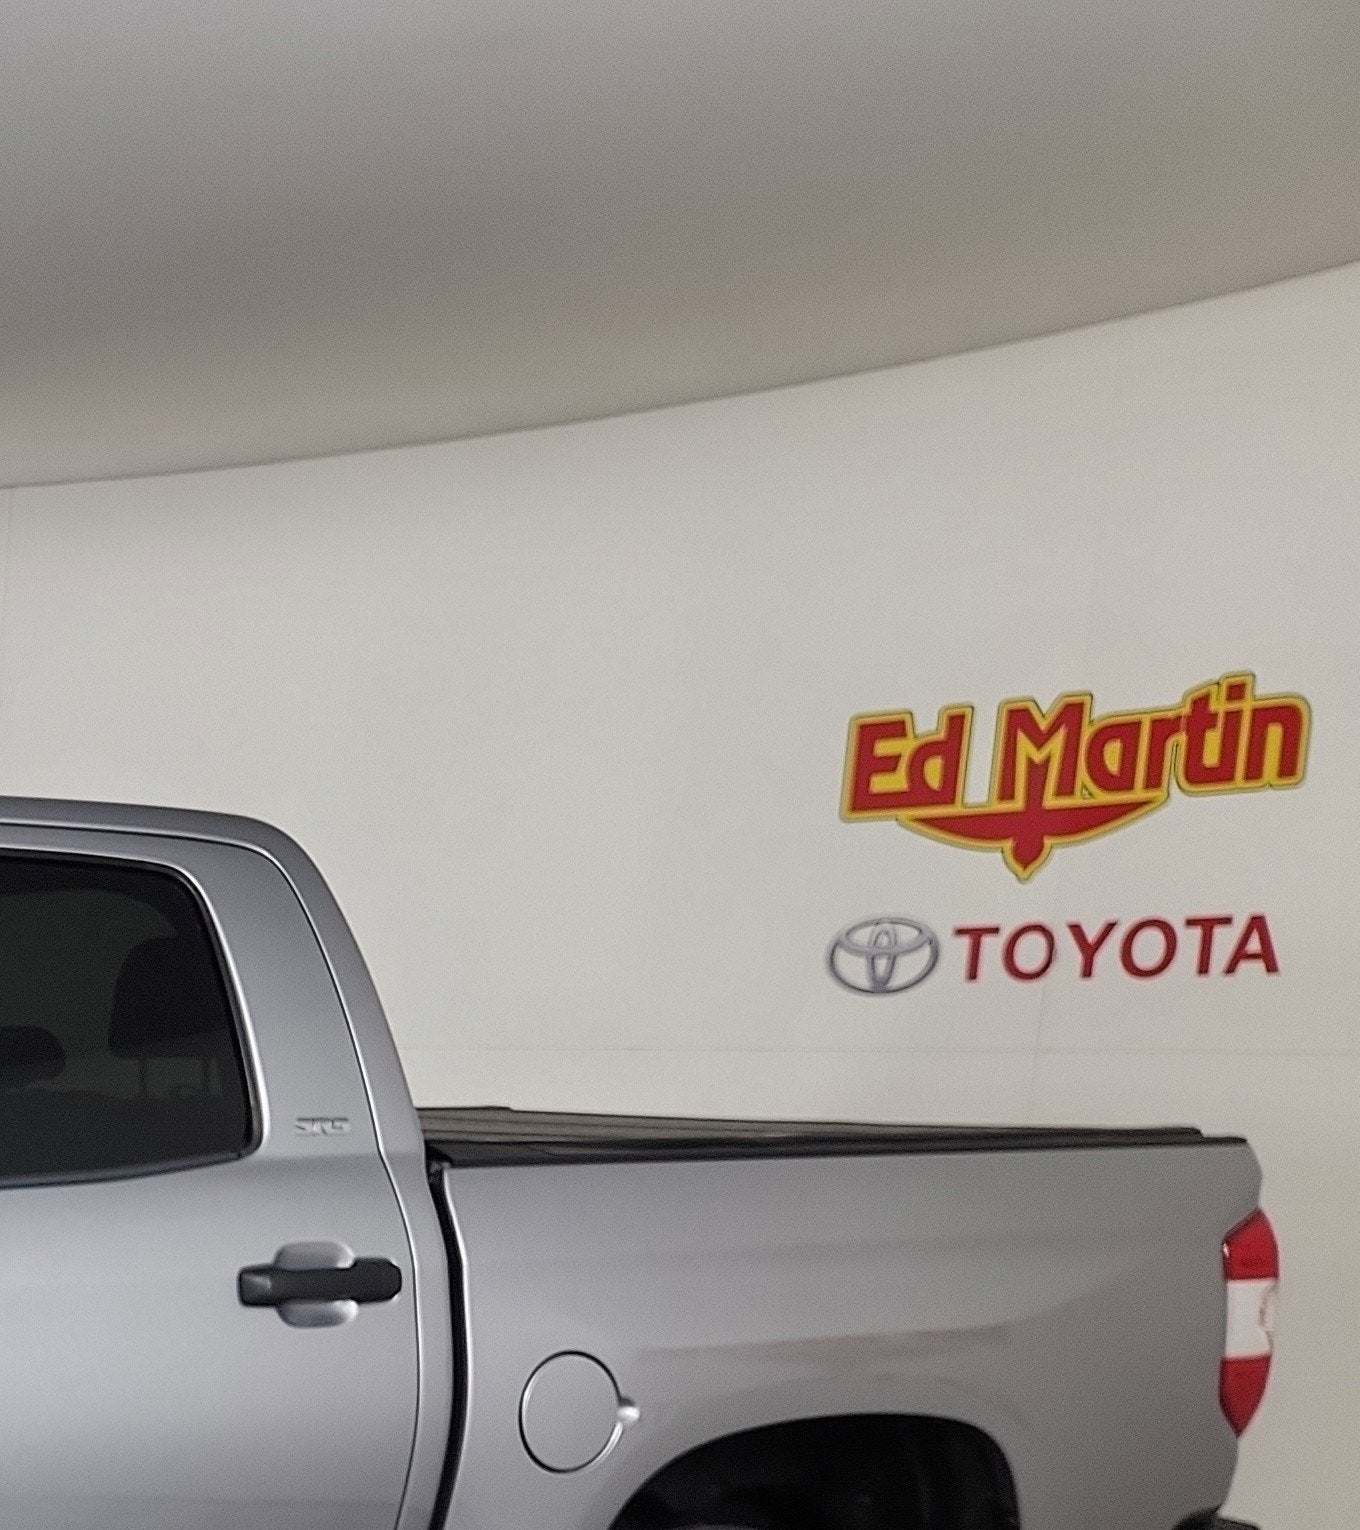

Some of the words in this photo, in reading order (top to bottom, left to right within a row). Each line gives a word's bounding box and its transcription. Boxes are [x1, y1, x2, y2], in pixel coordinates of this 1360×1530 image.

[842, 704, 975, 822] Ed
[988, 671, 1311, 802] Martin
[953, 912, 1281, 983] TOYOTA
